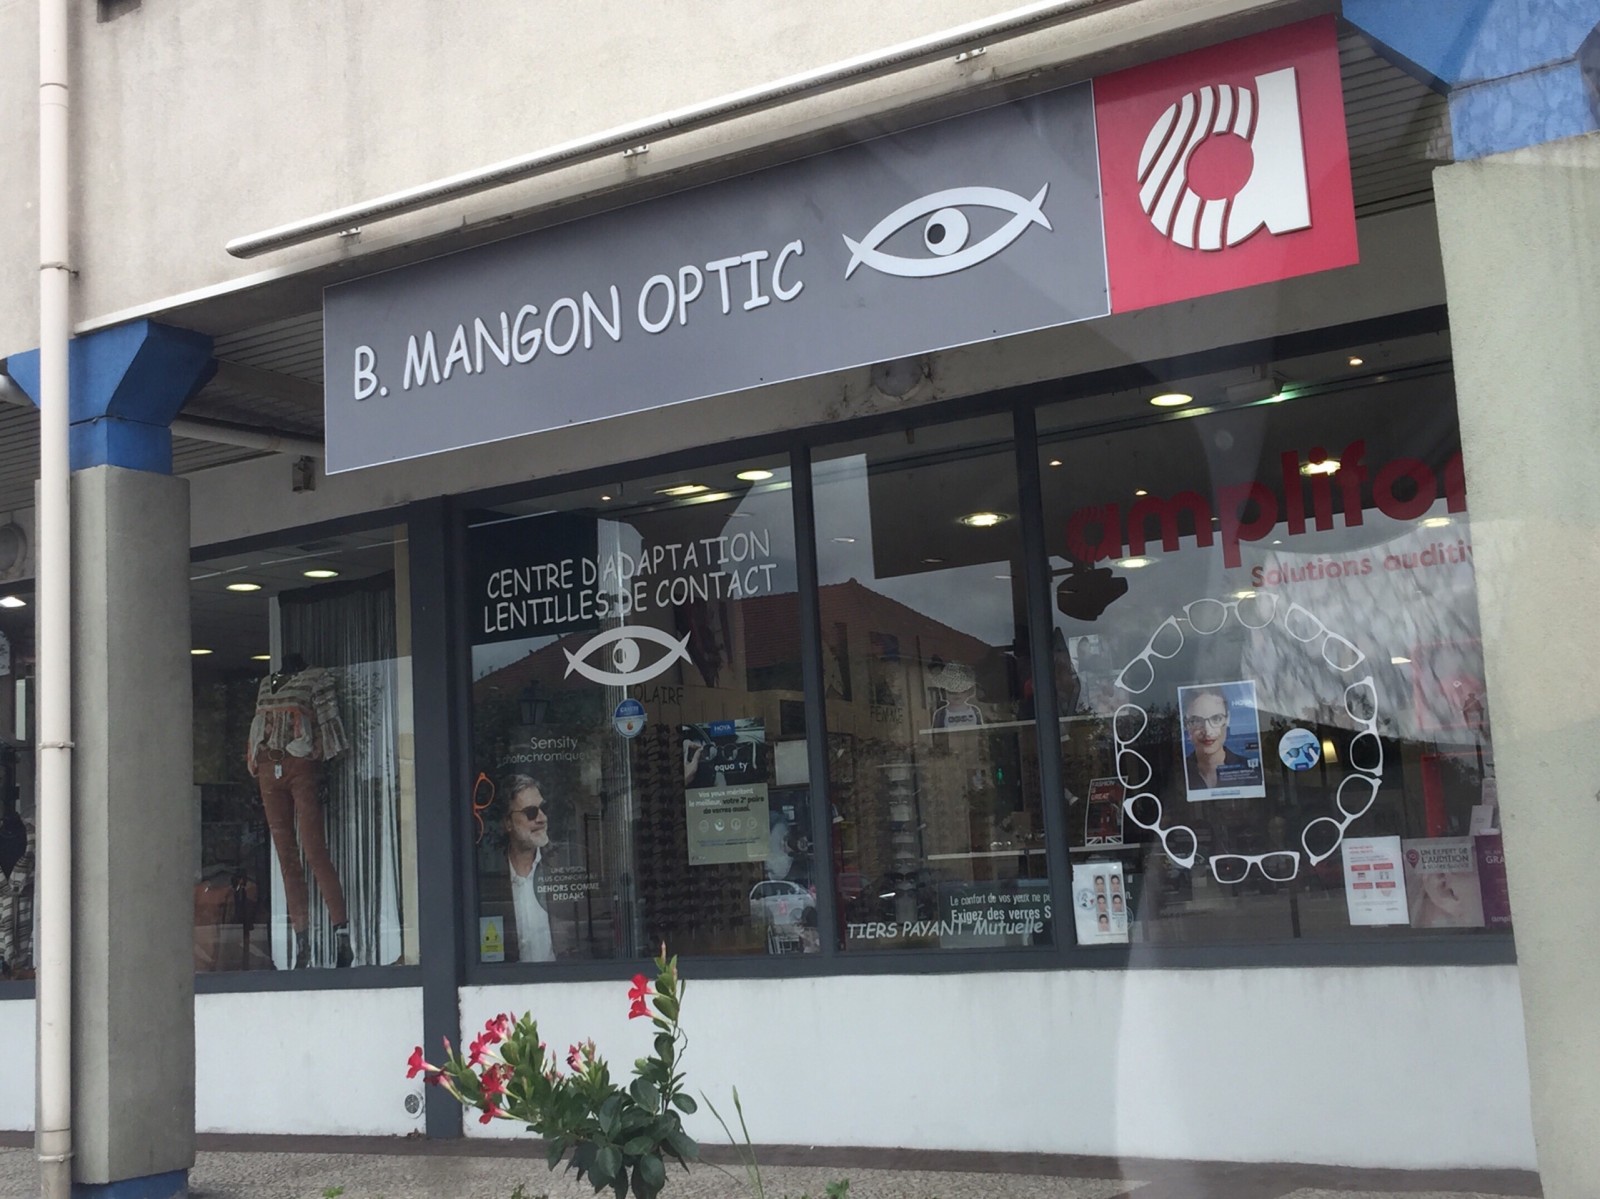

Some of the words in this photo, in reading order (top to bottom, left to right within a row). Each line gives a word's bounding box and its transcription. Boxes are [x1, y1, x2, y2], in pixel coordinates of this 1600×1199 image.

[353, 344, 389, 400] B.
[403, 284, 621, 390] MANGON
[637, 239, 803, 334] OPTIC
[487, 558, 574, 599] CENTRE
[582, 529, 769, 586] D'ADAPTATION
[1251, 553, 1372, 588] Solutions
[1383, 539, 1472, 571] auditi
[484, 589, 610, 633] LENTILLES
[618, 581, 647, 614] DE
[656, 563, 777, 608] CONTACT
[530, 736, 578, 751] Sensity
[537, 884, 569, 893] DEHORS
[950, 895, 959, 906] Le
[960, 893, 986, 905] confort
[987, 892, 997, 903] de
[998, 894, 1011, 903] vos
[1012, 893, 1030, 905] yeux
[1031, 894, 1040, 903] ne
[951, 908, 984, 924] Exigez
[987, 907, 1005, 920] des
[1009, 908, 1040, 920] verres
[847, 922, 898, 939] TIERS
[902, 918, 963, 938] PAYANT
[973, 917, 1044, 936] Mutuelle
